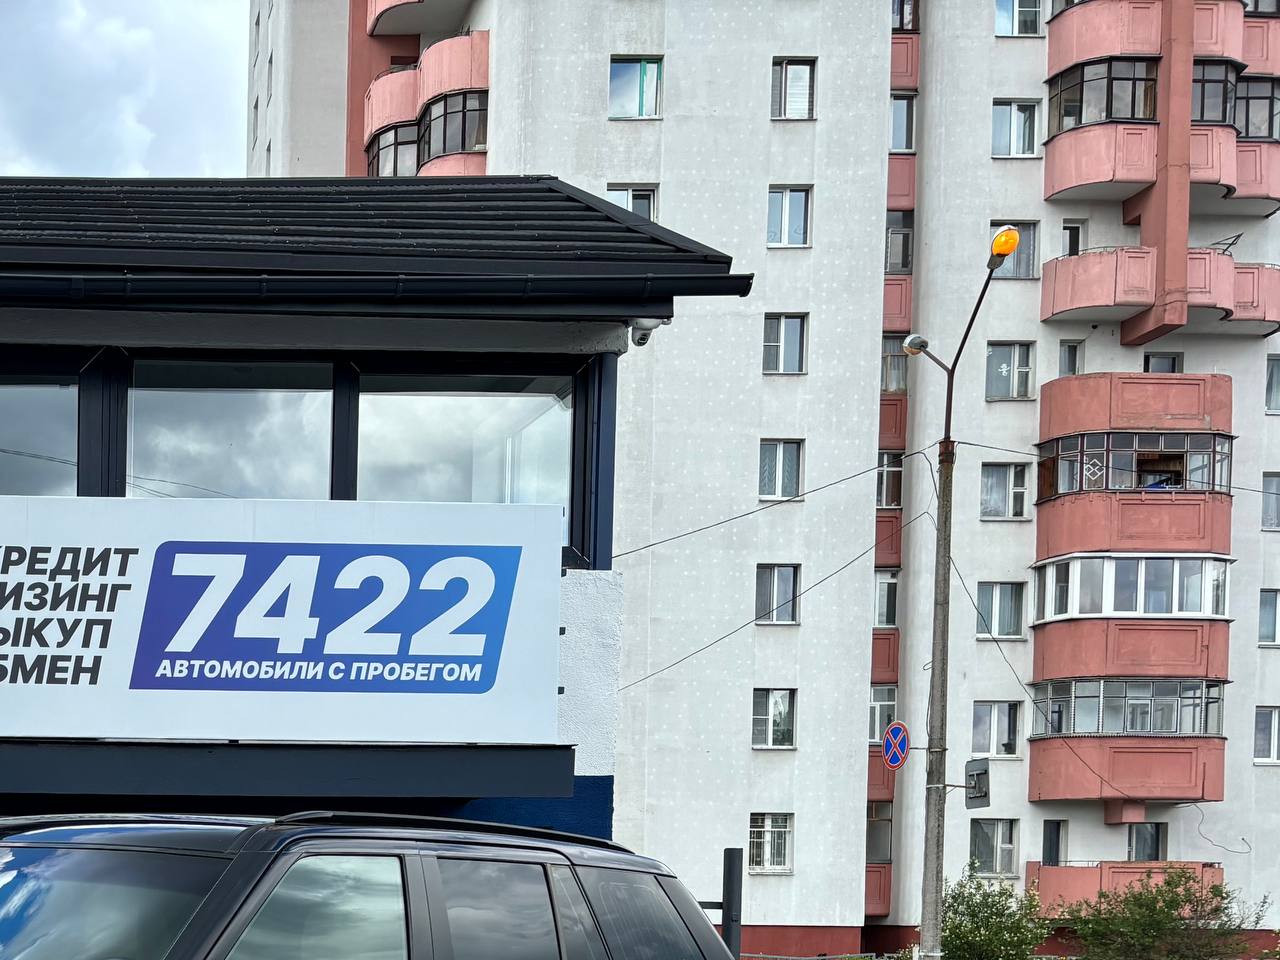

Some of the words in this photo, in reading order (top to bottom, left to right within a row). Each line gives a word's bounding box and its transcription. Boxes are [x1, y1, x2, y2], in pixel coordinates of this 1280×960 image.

[164, 553, 496, 657] 7422
[154, 659, 325, 680] АВТОМОБИЛИ
[328, 661, 346, 680] С
[349, 662, 483, 682] ПРОБЕГОМ
